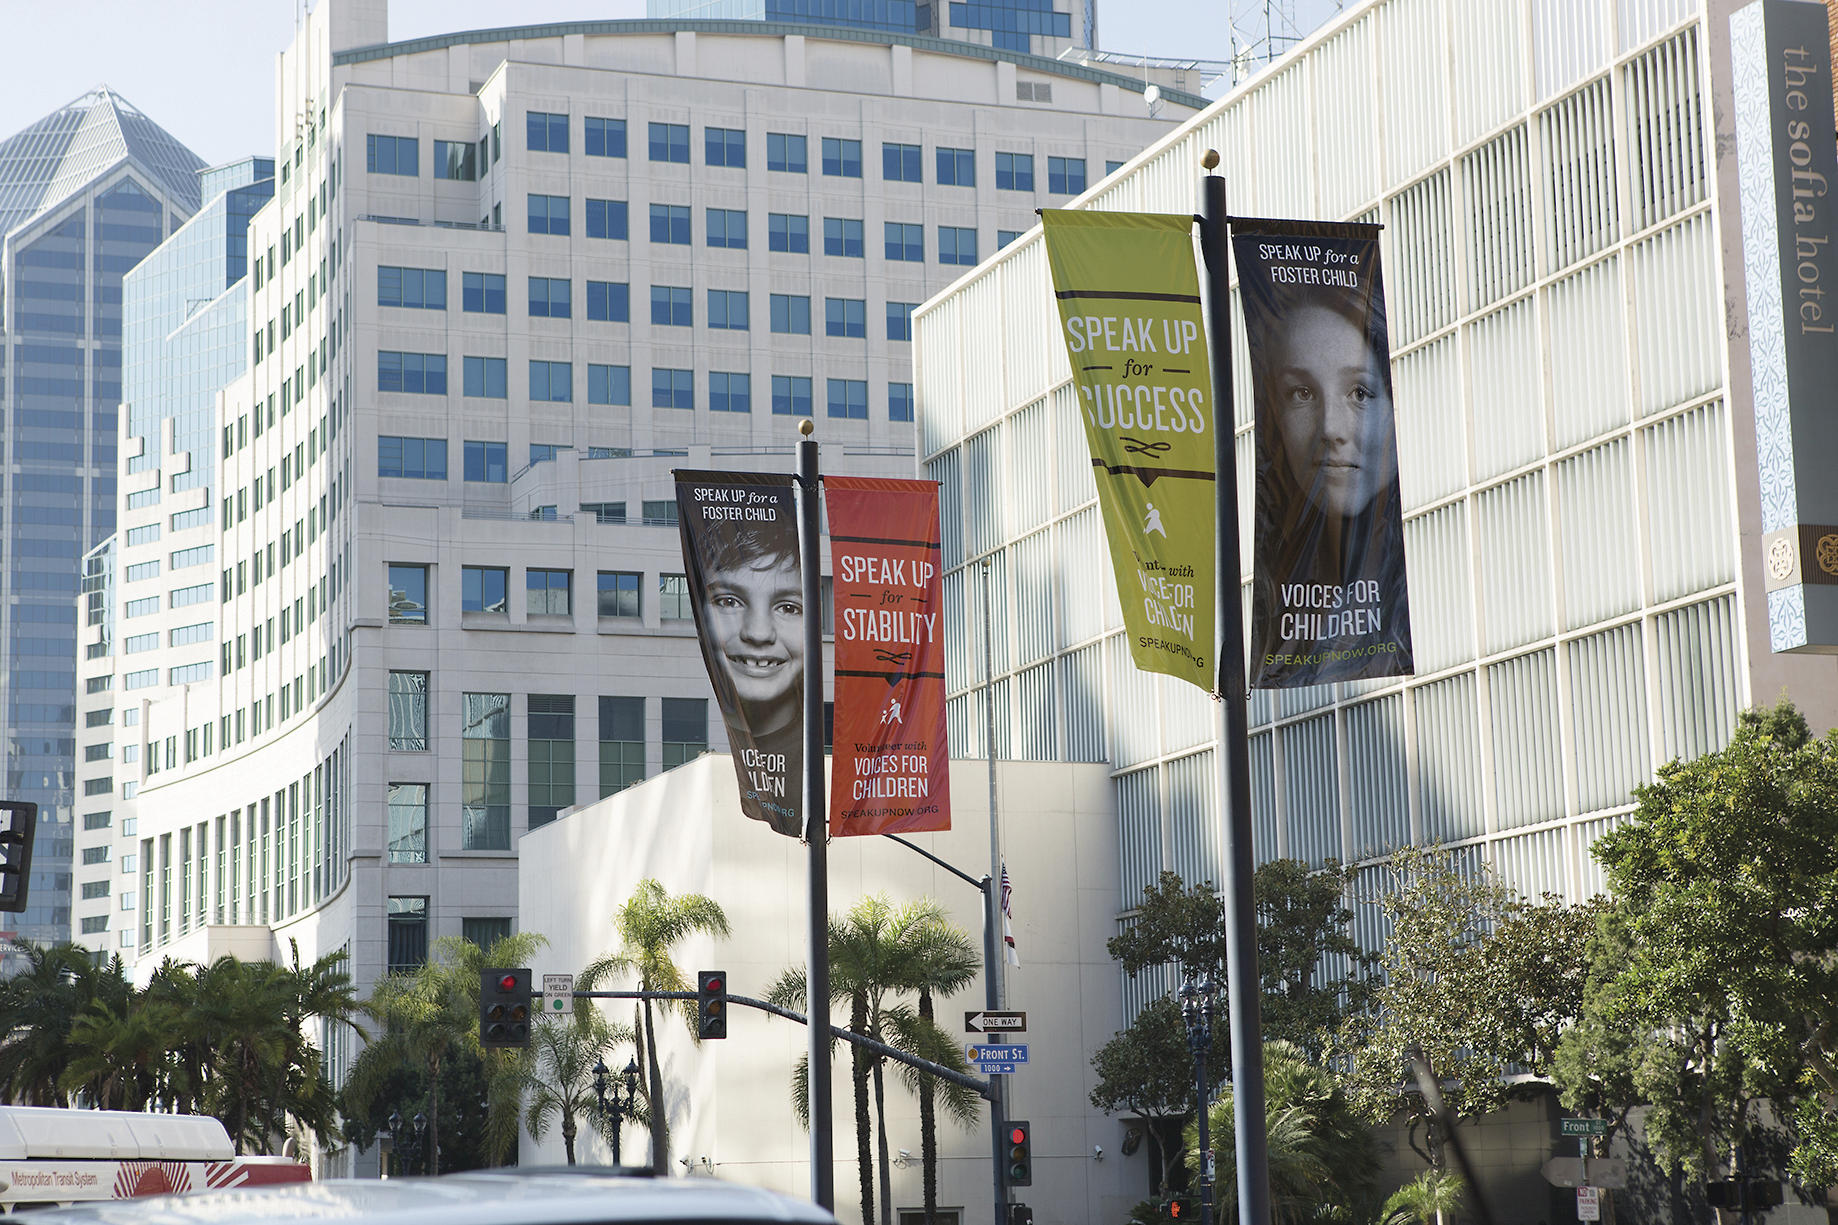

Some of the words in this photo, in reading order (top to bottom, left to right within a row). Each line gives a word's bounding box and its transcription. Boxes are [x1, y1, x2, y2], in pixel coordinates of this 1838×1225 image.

[1783, 45, 1817, 111] the
[1787, 119, 1828, 224] sofia
[1259, 244, 1302, 260] SPEAK
[1304, 246, 1321, 261] UP
[1324, 249, 1347, 265] for
[1350, 254, 1360, 265] a
[1271, 266, 1320, 284] FOSTER
[1322, 269, 1358, 288] CHILD
[1795, 233, 1834, 336] hotel
[1067, 316, 1157, 352] SPEAK
[1163, 320, 1197, 354] UP
[1122, 358, 1153, 379] for
[694, 488, 729, 502] SPEAK
[731, 489, 746, 502] UP
[747, 492, 767, 505] for
[770, 495, 778, 504] a
[702, 506, 743, 520] FOSTER
[745, 508, 777, 521] CHILD
[841, 555, 906, 586] SPEAK
[912, 560, 934, 589] UP
[1169, 565, 1194, 578] with
[880, 590, 903, 605] for
[1281, 584, 1343, 609] VOICES
[1347, 580, 1380, 604] FOR
[843, 608, 936, 645] STABILITY
[1280, 608, 1382, 641] CHILDREN
[1265, 642, 1397, 665] SPEAKUPNOW.ORG
[905, 741, 927, 751] with
[854, 755, 898, 776] VOICES
[902, 755, 928, 773] FOR
[853, 777, 928, 800] CHILDREN
[840, 805, 939, 819] SPEAKUPNOWORG
[983, 1018, 998, 1026] ONE
[1001, 1018, 1016, 1026] WAY
[981, 1048, 1008, 1060] FRONT
[1563, 1121, 1590, 1132] Front
[11, 1171, 52, 1189] Metropolitan
[52, 1171, 74, 1186] Transit
[74, 1171, 98, 1189] System
